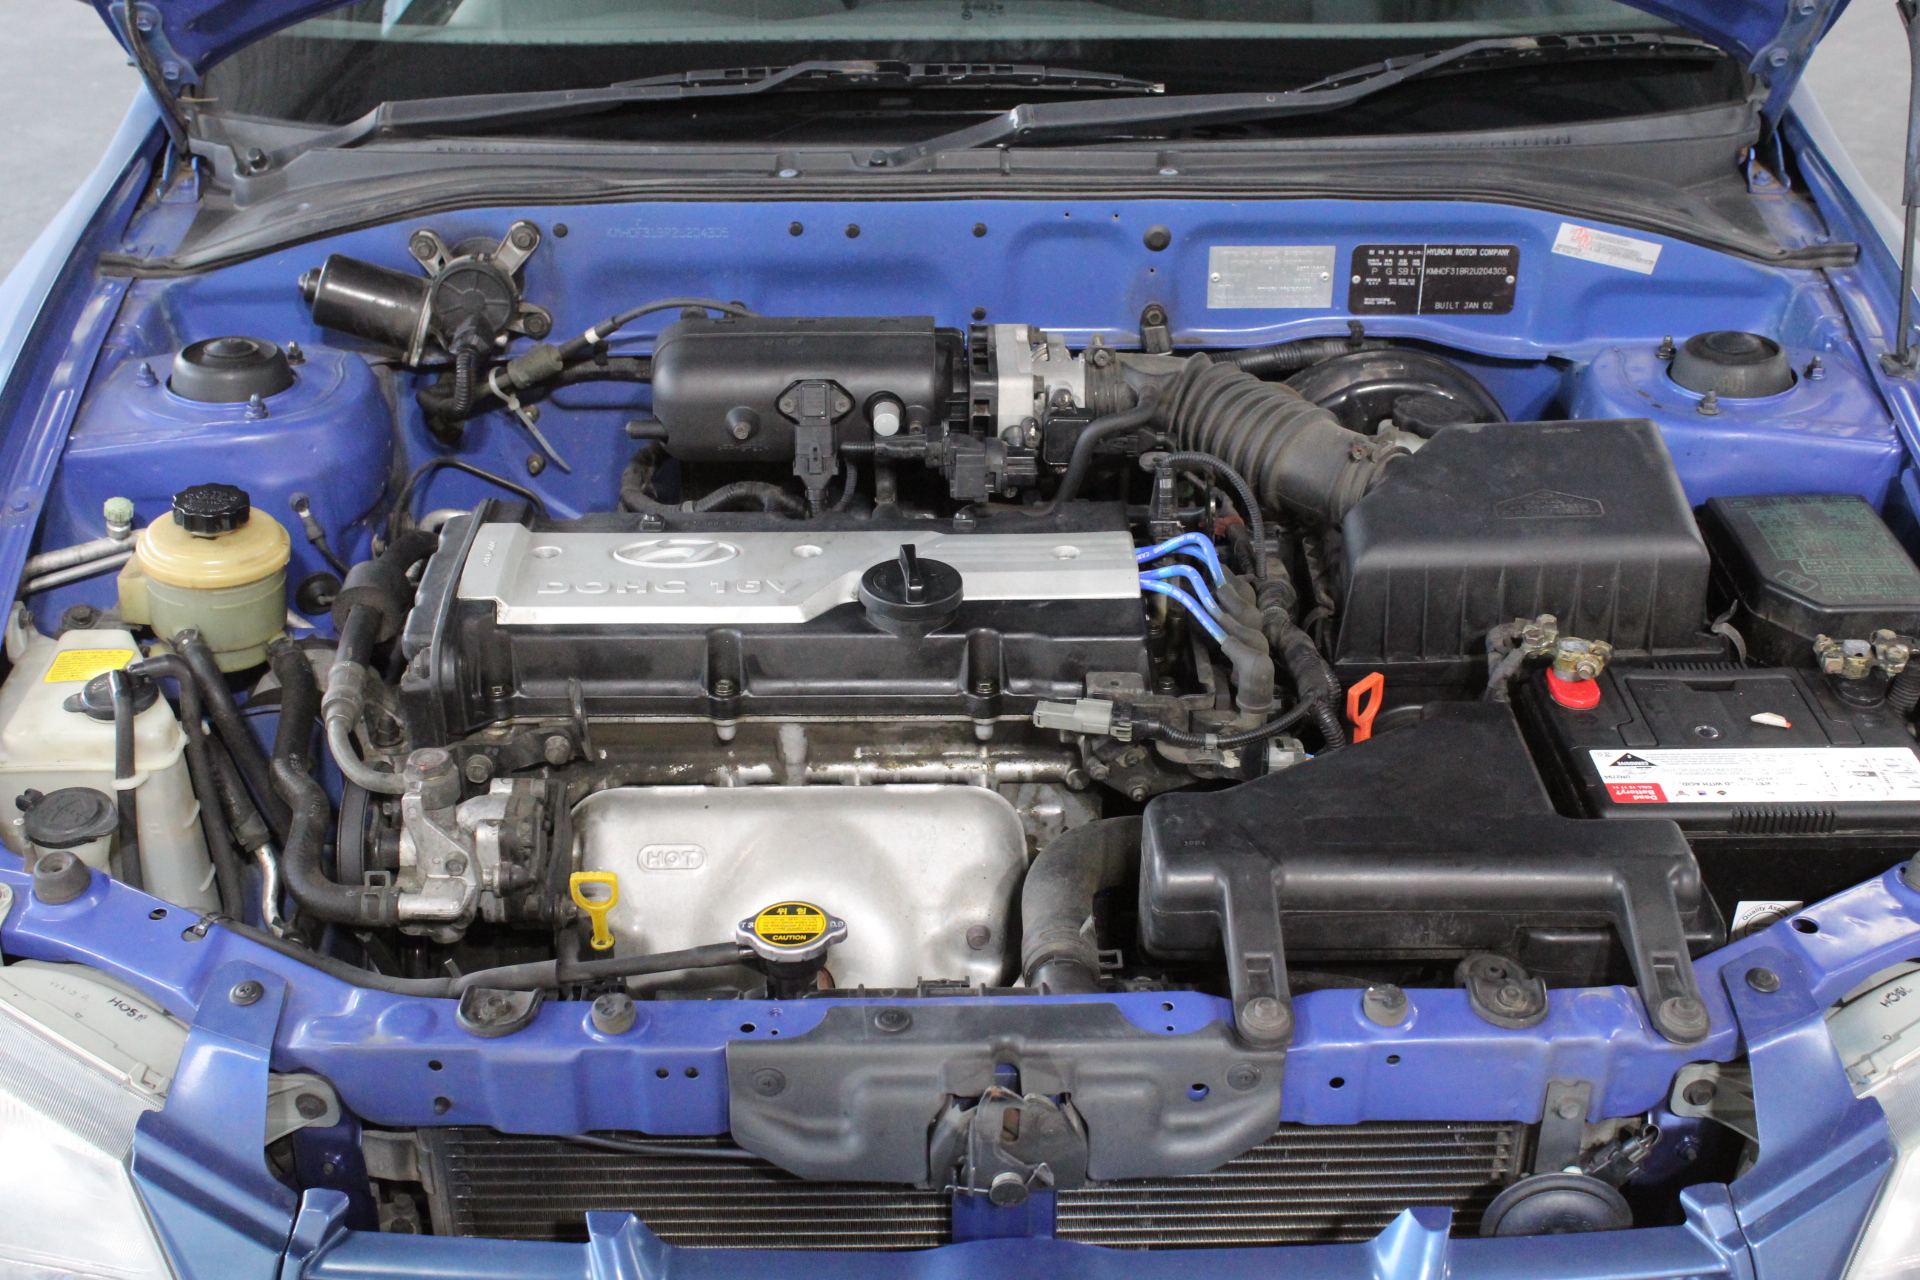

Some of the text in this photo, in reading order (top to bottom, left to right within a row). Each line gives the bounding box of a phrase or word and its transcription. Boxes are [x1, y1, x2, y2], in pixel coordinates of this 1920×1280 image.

[1426, 248, 1511, 256] HYUNDAI MOTOR COMPANY
[1371, 267, 1379, 275] P
[1385, 267, 1393, 275] G
[1434, 301, 1494, 310] BUILT JAN 02
[537, 579, 801, 594] DOHC 16V
[646, 850, 700, 866] HOT
[1742, 905, 1766, 921] Quality
